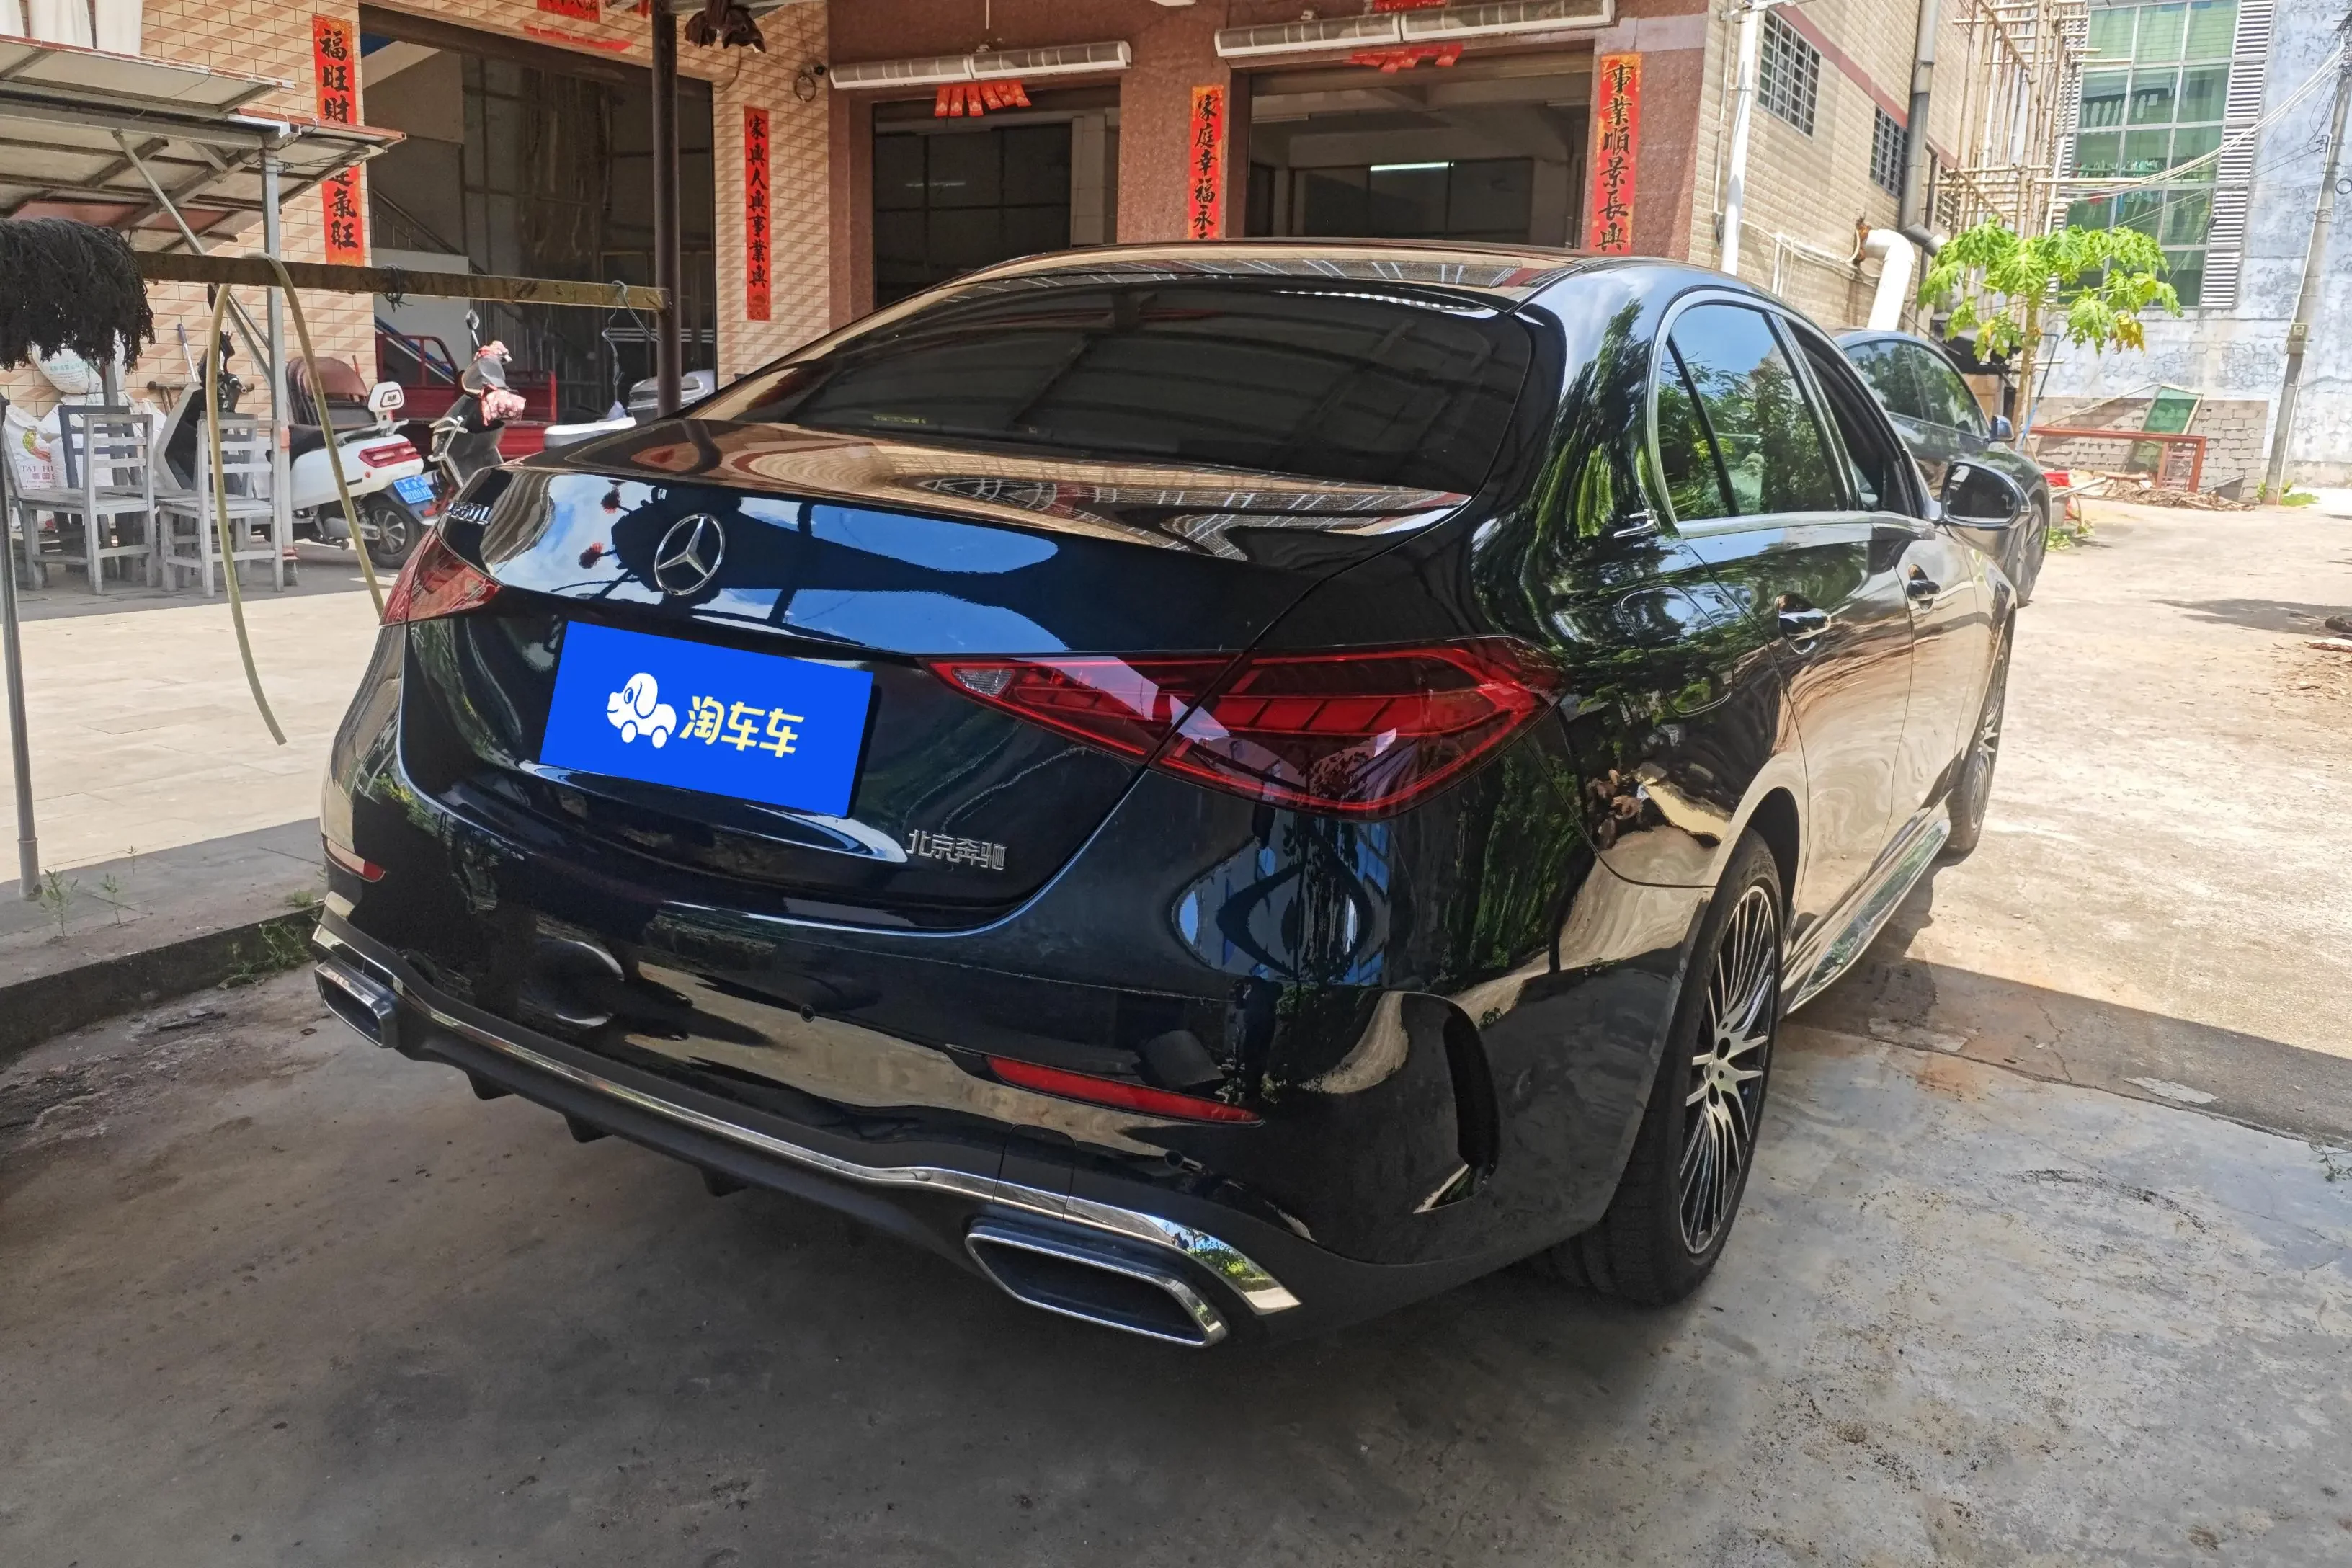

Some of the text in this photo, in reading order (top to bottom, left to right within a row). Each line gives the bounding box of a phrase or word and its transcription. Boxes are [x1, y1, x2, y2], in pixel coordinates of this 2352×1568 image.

[1193, 94, 1218, 239] 家庭幸福永
[906, 829, 1009, 870] 北京奔驰
